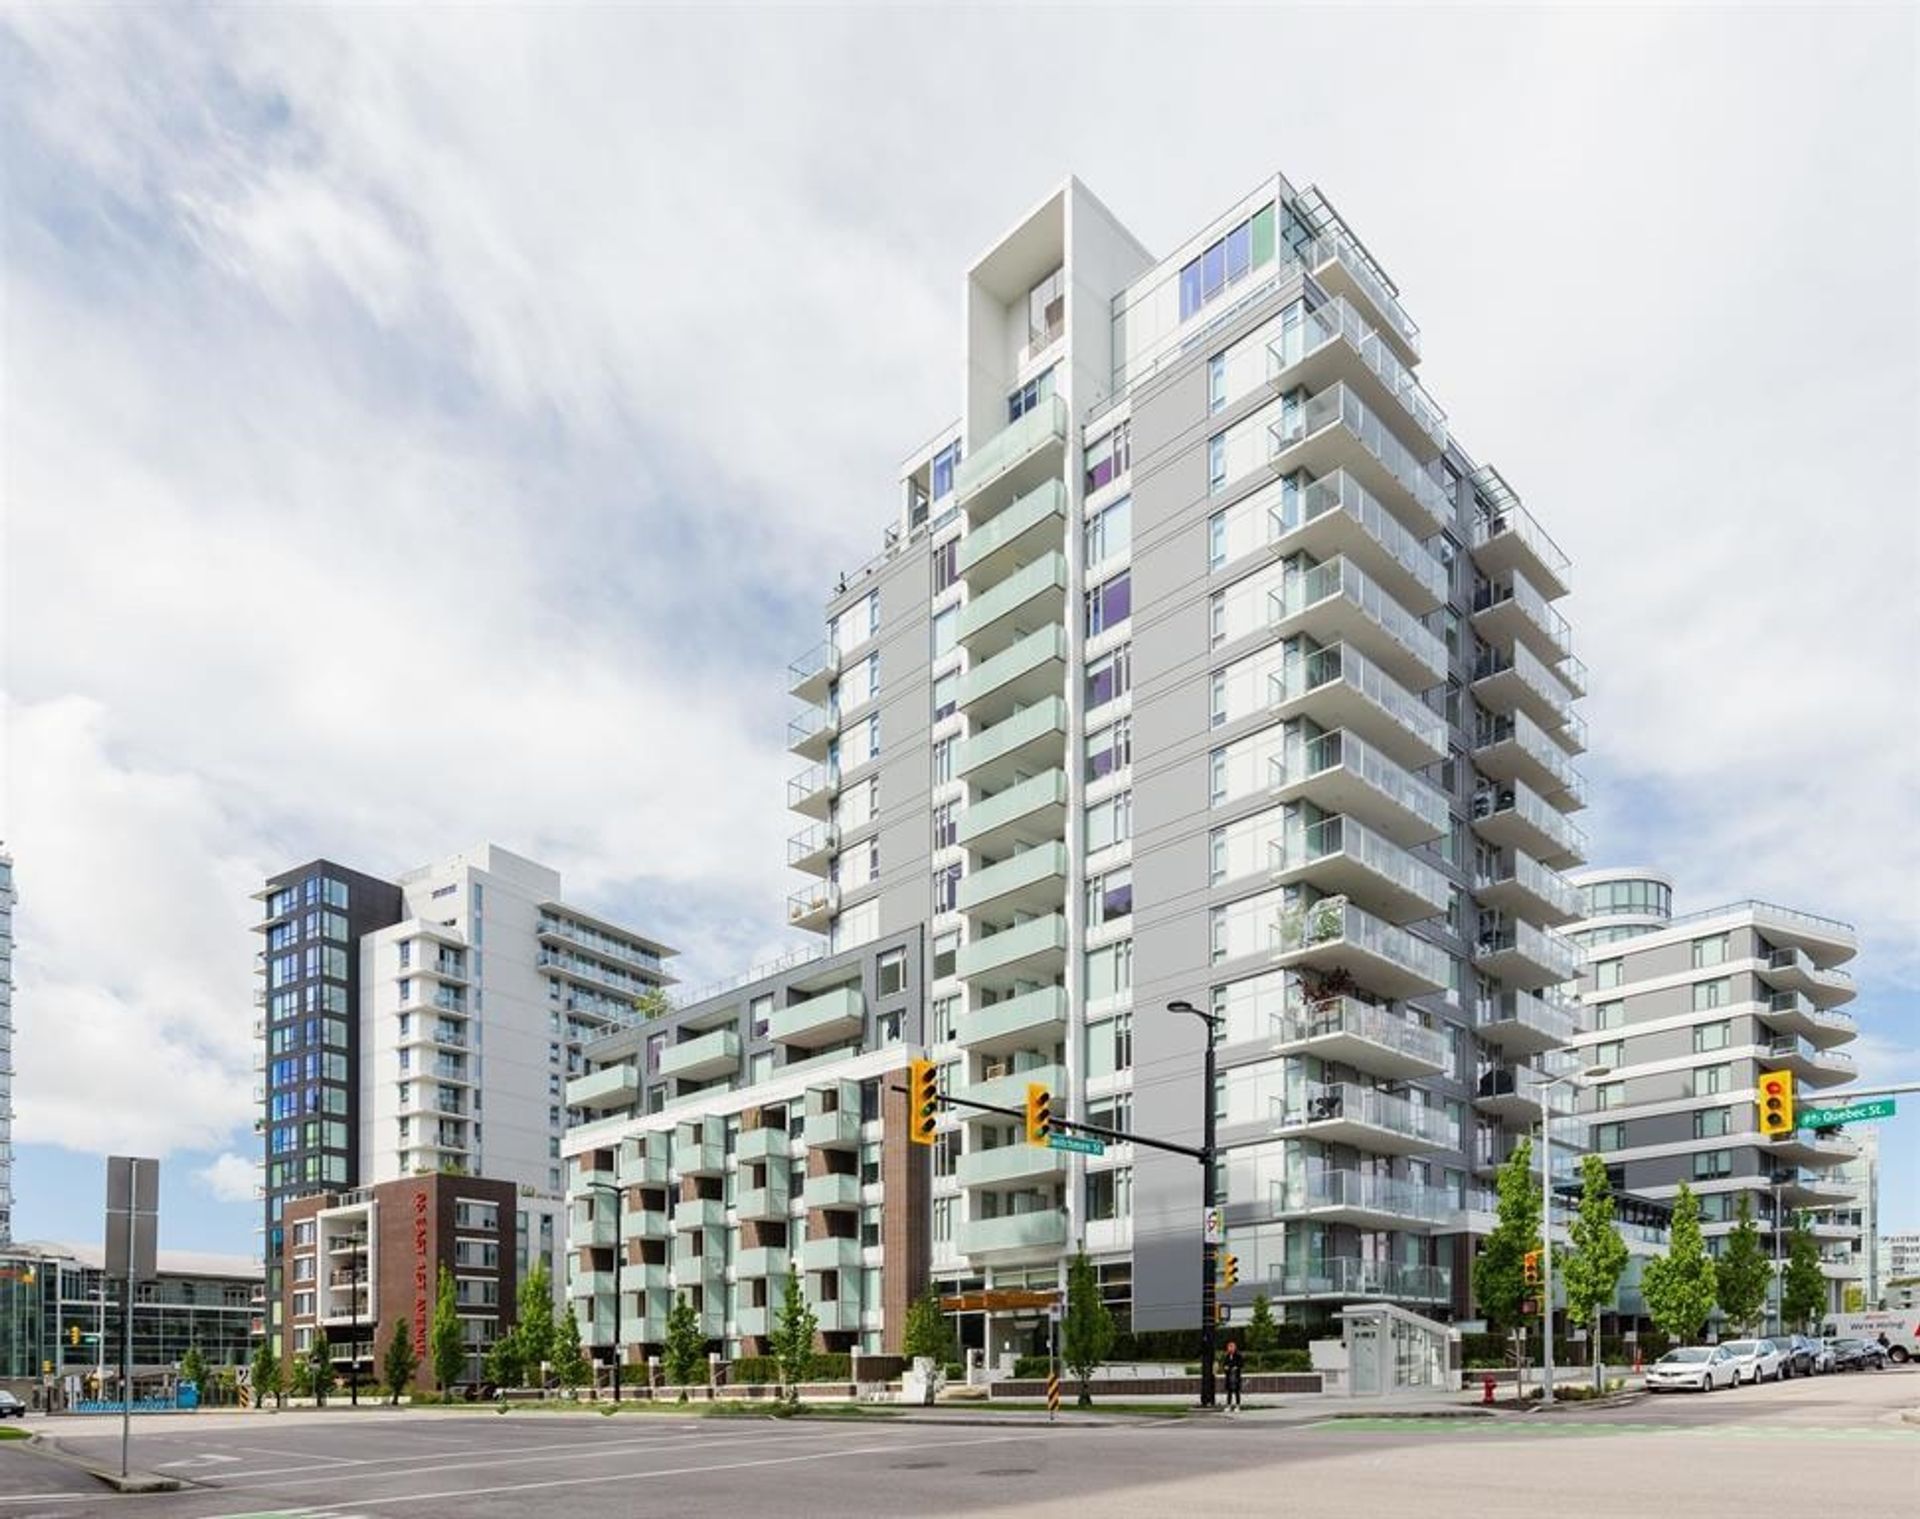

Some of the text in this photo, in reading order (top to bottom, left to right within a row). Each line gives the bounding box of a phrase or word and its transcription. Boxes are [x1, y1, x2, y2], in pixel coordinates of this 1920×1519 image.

[1823, 1108, 1867, 1122] Quebec
[415, 1217, 427, 1256] EAST
[415, 1298, 427, 1360] AVENUE
